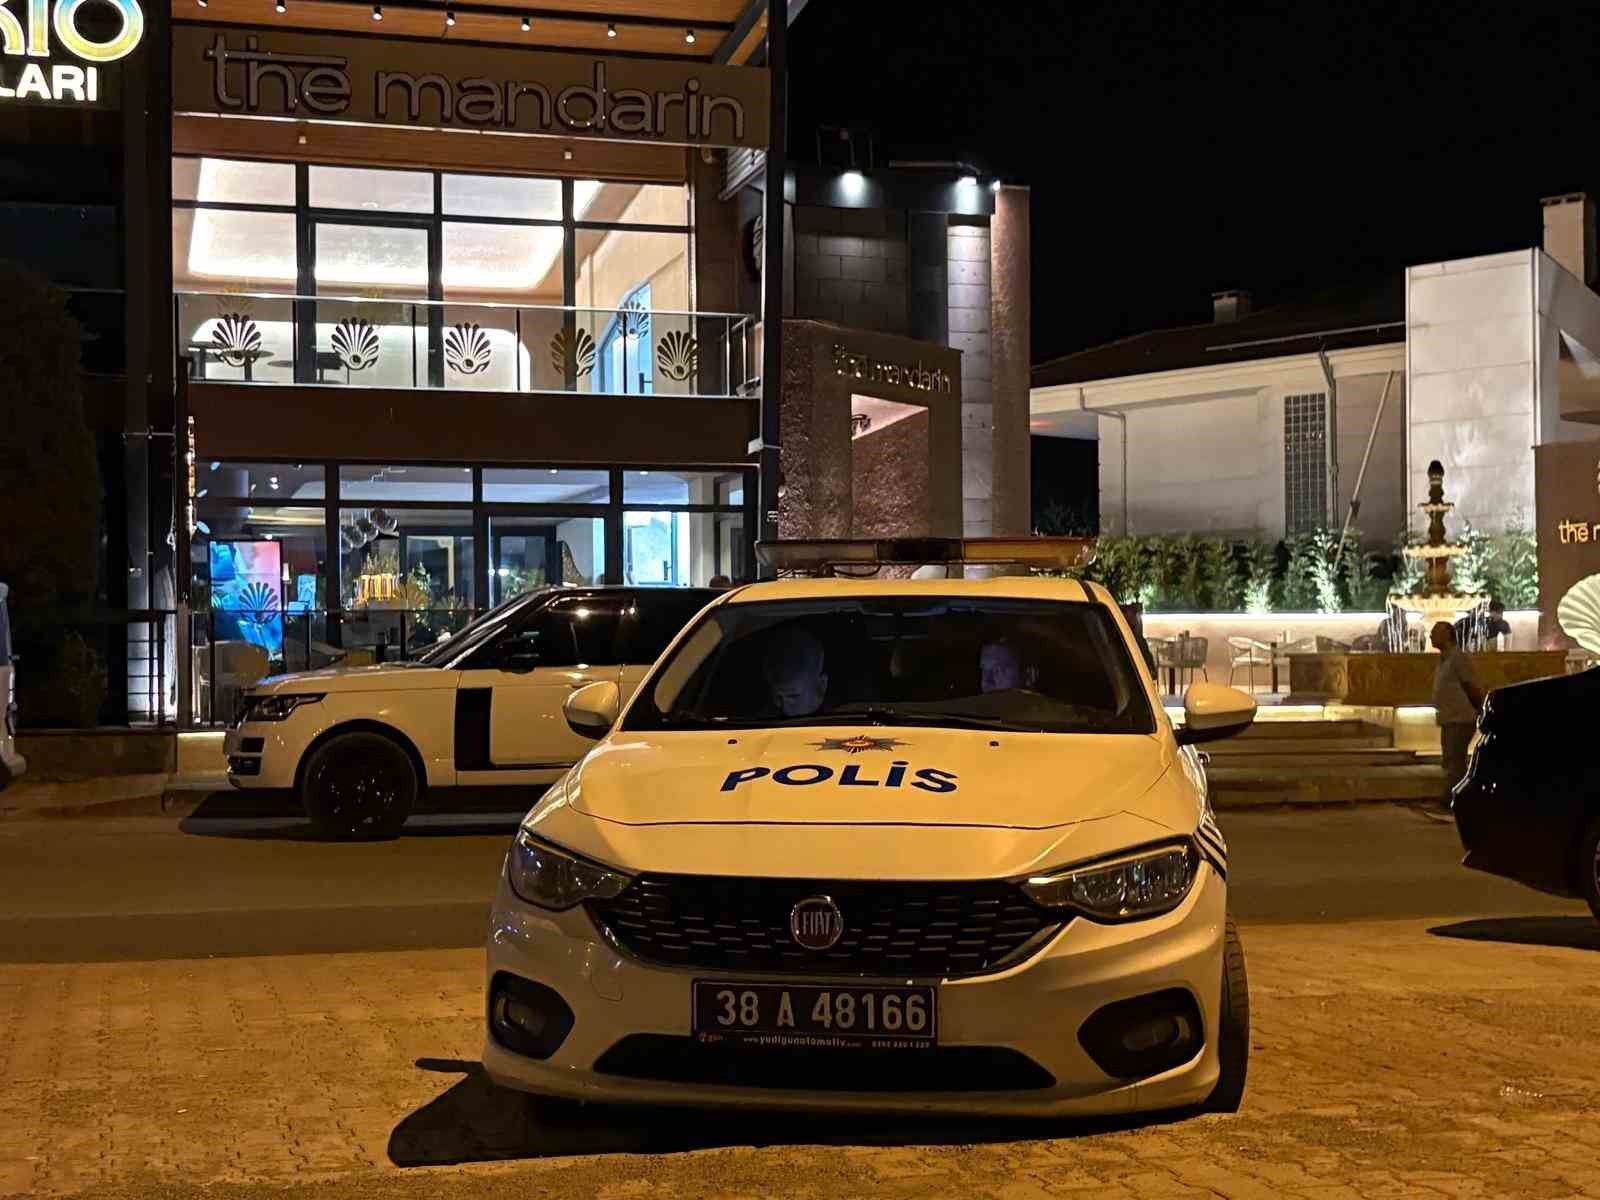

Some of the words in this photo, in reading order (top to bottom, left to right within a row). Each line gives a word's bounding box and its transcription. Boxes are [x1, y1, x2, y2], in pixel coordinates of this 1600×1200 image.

[206, 34, 350, 114] the
[374, 60, 746, 140] mandarin
[871, 359, 952, 393] mandarin
[1558, 519, 1589, 544] the
[802, 911, 832, 936] FIAT
[716, 990, 760, 1027] 38
[776, 991, 796, 1028] A
[810, 992, 927, 1032] 48166
